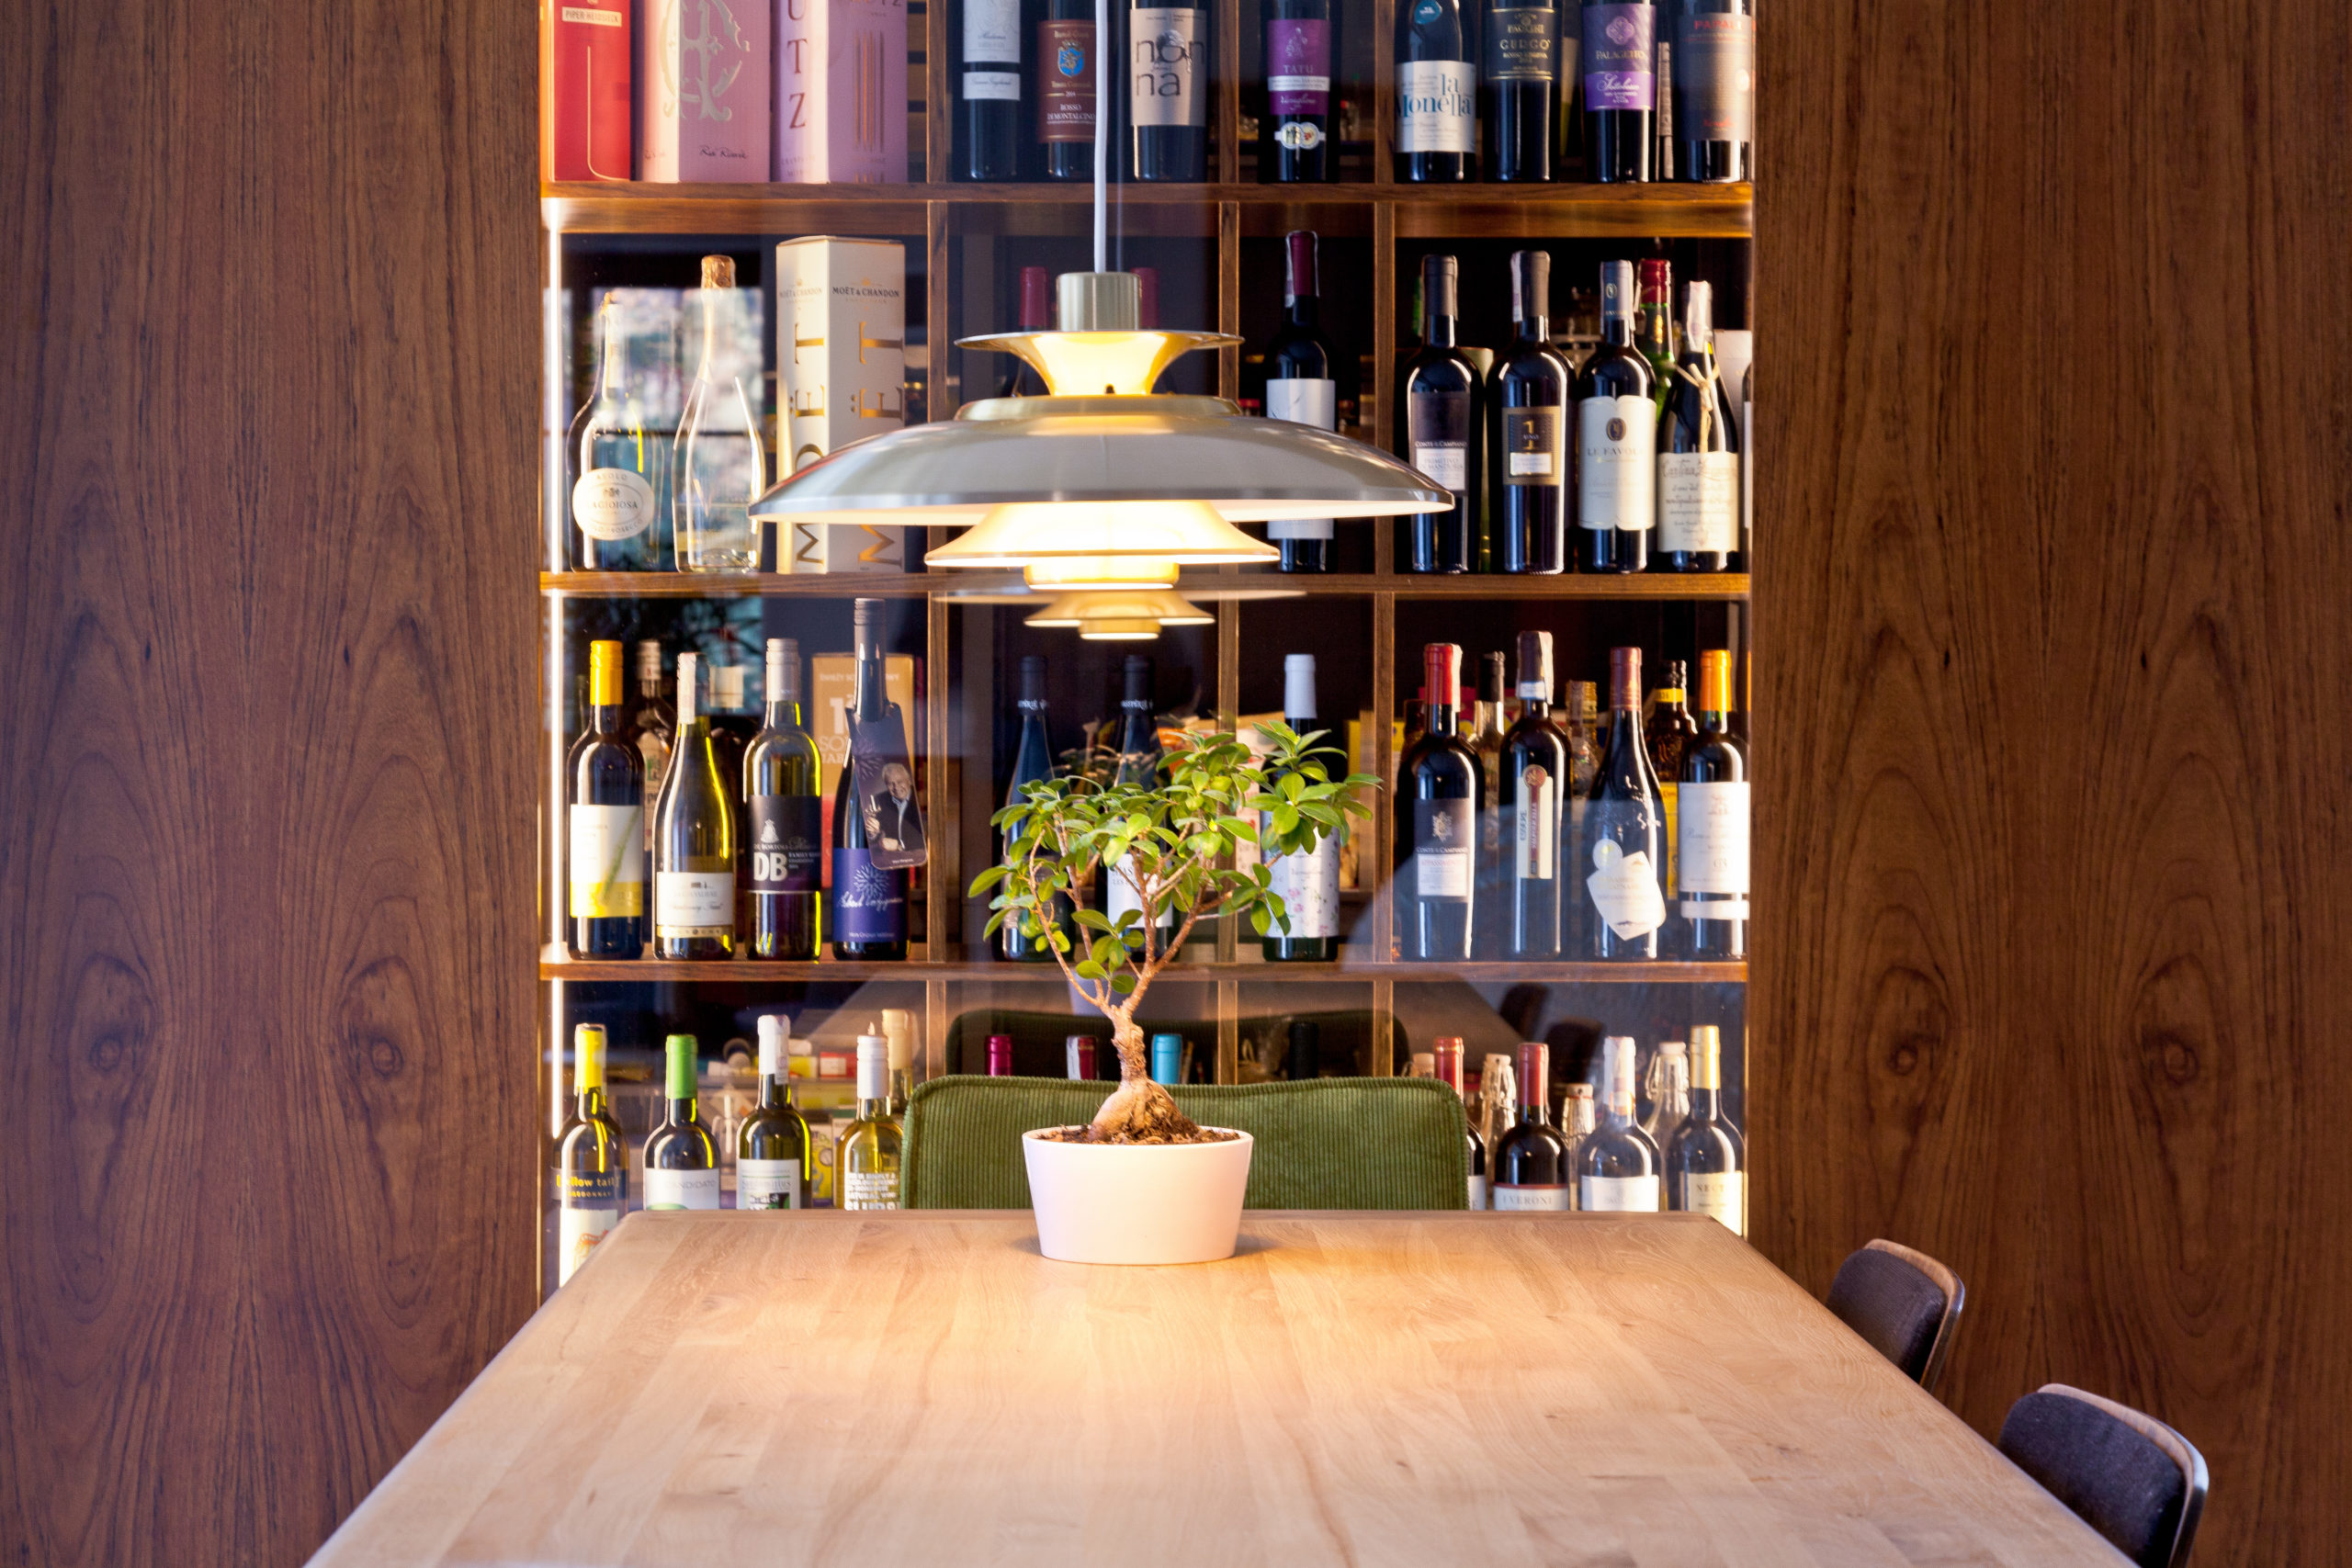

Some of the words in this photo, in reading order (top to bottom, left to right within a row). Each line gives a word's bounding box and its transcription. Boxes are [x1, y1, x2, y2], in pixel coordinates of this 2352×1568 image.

[1442, 73, 1459, 96] la
[831, 286, 854, 295] MOËT
[863, 288, 899, 298] CHANDON
[753, 852, 788, 882] DB
